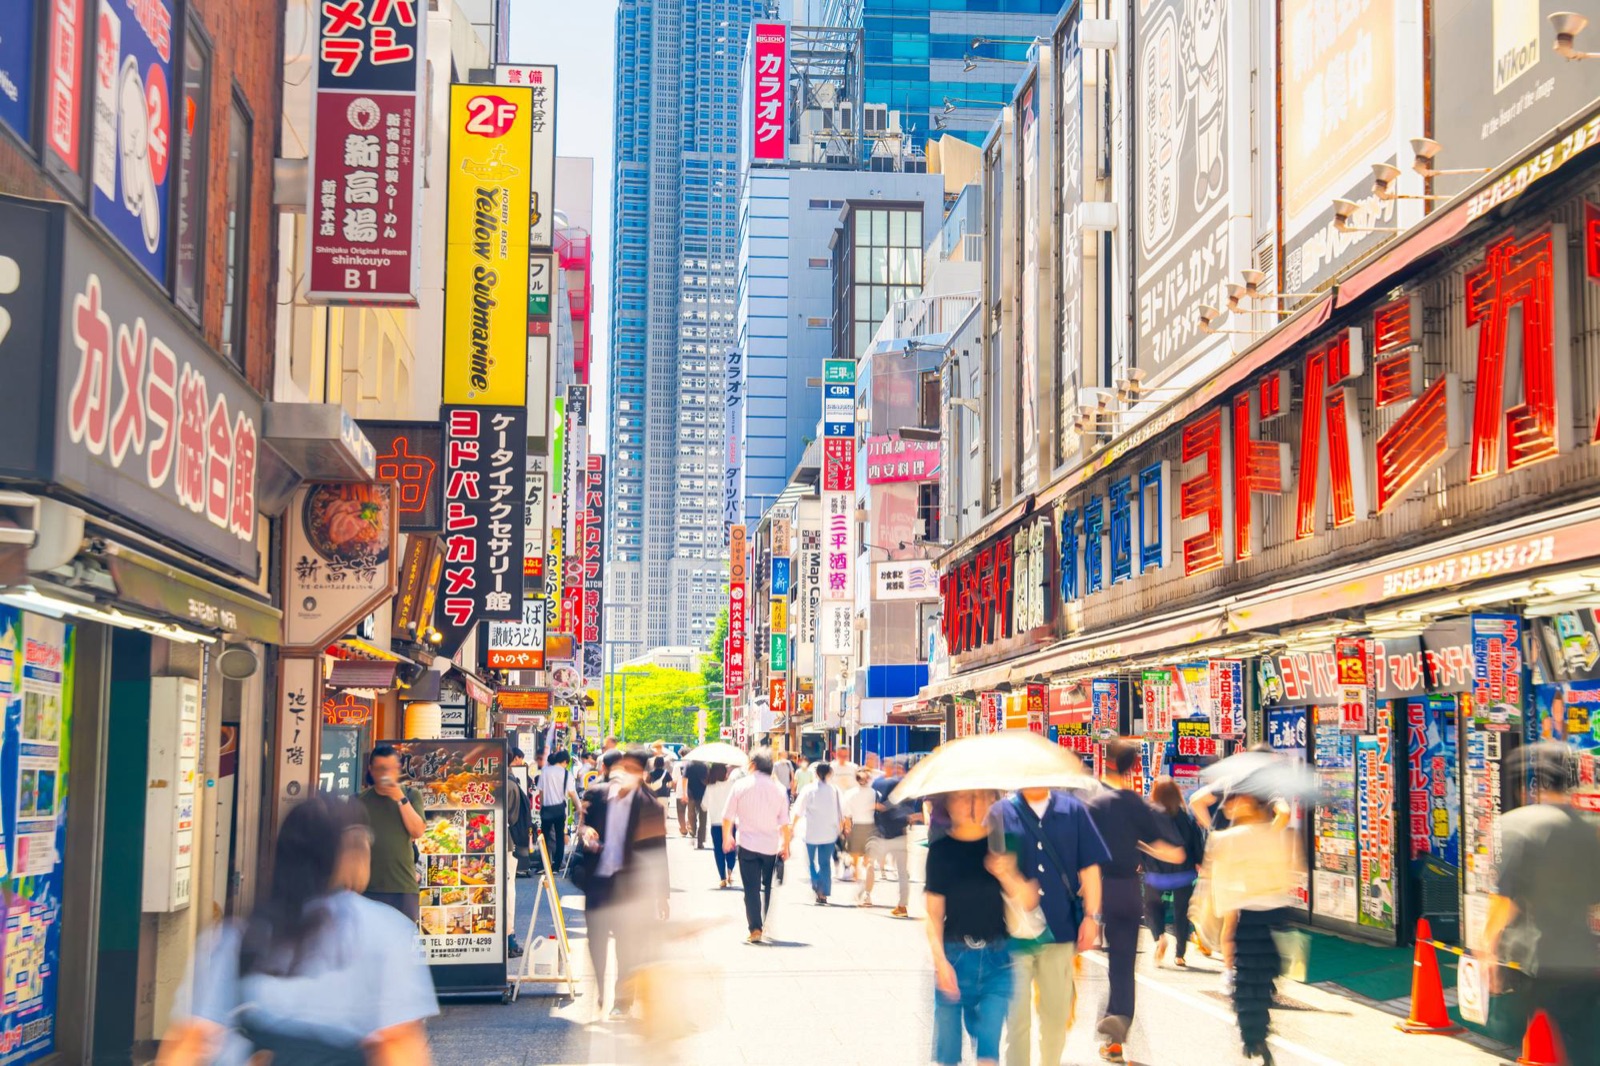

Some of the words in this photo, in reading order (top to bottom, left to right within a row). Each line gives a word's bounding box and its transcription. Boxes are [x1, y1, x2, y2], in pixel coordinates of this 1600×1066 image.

[508, 69, 543, 84] 警備
[1496, 40, 1538, 89] Nikon
[467, 97, 517, 133] 2F
[757, 53, 782, 143] カラオケ
[1466, 147, 1555, 224] ヨドバシカメラ
[476, 187, 500, 260] Yellow
[501, 189, 509, 225] HOBBY
[316, 246, 348, 254] Shinjuku
[332, 256, 391, 267] shinkouyo
[499, 230, 508, 259] BASE
[344, 270, 377, 290] B1
[1141, 219, 1229, 338] ヨドバシカメラ
[471, 266, 499, 390] Submarine
[727, 352, 742, 407] カラオケ
[829, 366, 848, 379] 三平
[830, 386, 850, 395] CBR
[68, 273, 257, 542] カメラ総合館
[1180, 205, 1600, 578] ヨドバシカ
[833, 425, 847, 435] 5F
[868, 461, 925, 479] 西安料理
[725, 468, 740, 520] ダーツバー
[445, 410, 479, 627] ヨドバシカメラ
[485, 413, 515, 612] ケータイアクセサリー館
[586, 455, 602, 578] ヨドバシカメラ
[1382, 564, 1455, 597] ヨドバシカメラ
[584, 591, 600, 642] 時計館
[491, 627, 541, 647] 讃岐うどん
[493, 653, 529, 664] かのや
[1179, 736, 1217, 755] 機種
[473, 757, 499, 775] 4F
[431, 938, 442, 946] TEL
